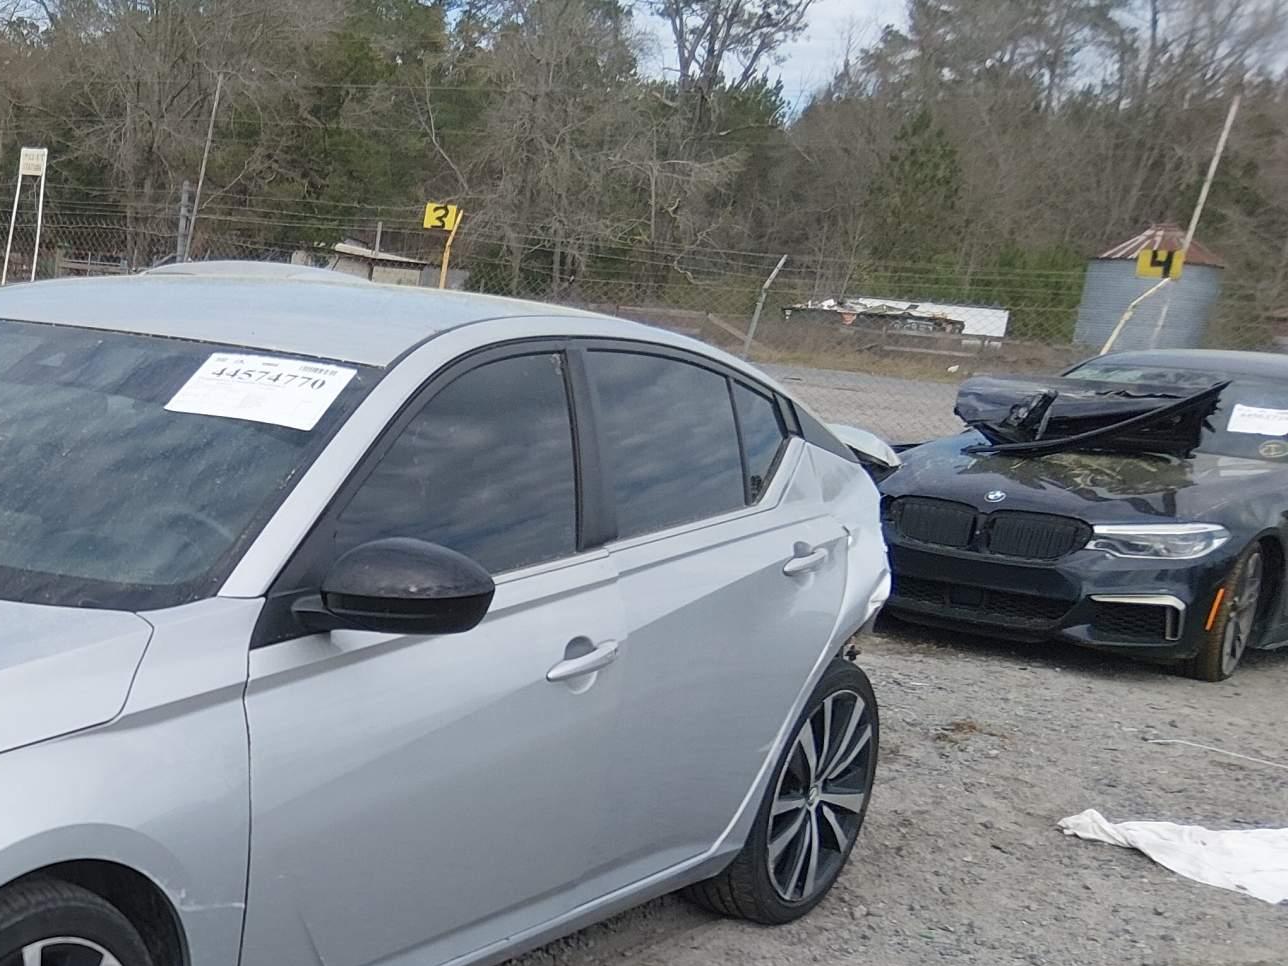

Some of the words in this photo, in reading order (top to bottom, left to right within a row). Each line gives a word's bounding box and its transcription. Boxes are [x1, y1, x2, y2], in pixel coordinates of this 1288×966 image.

[432, 204, 449, 228] 3
[1150, 250, 1174, 278] 4
[211, 367, 327, 390] 44574770
